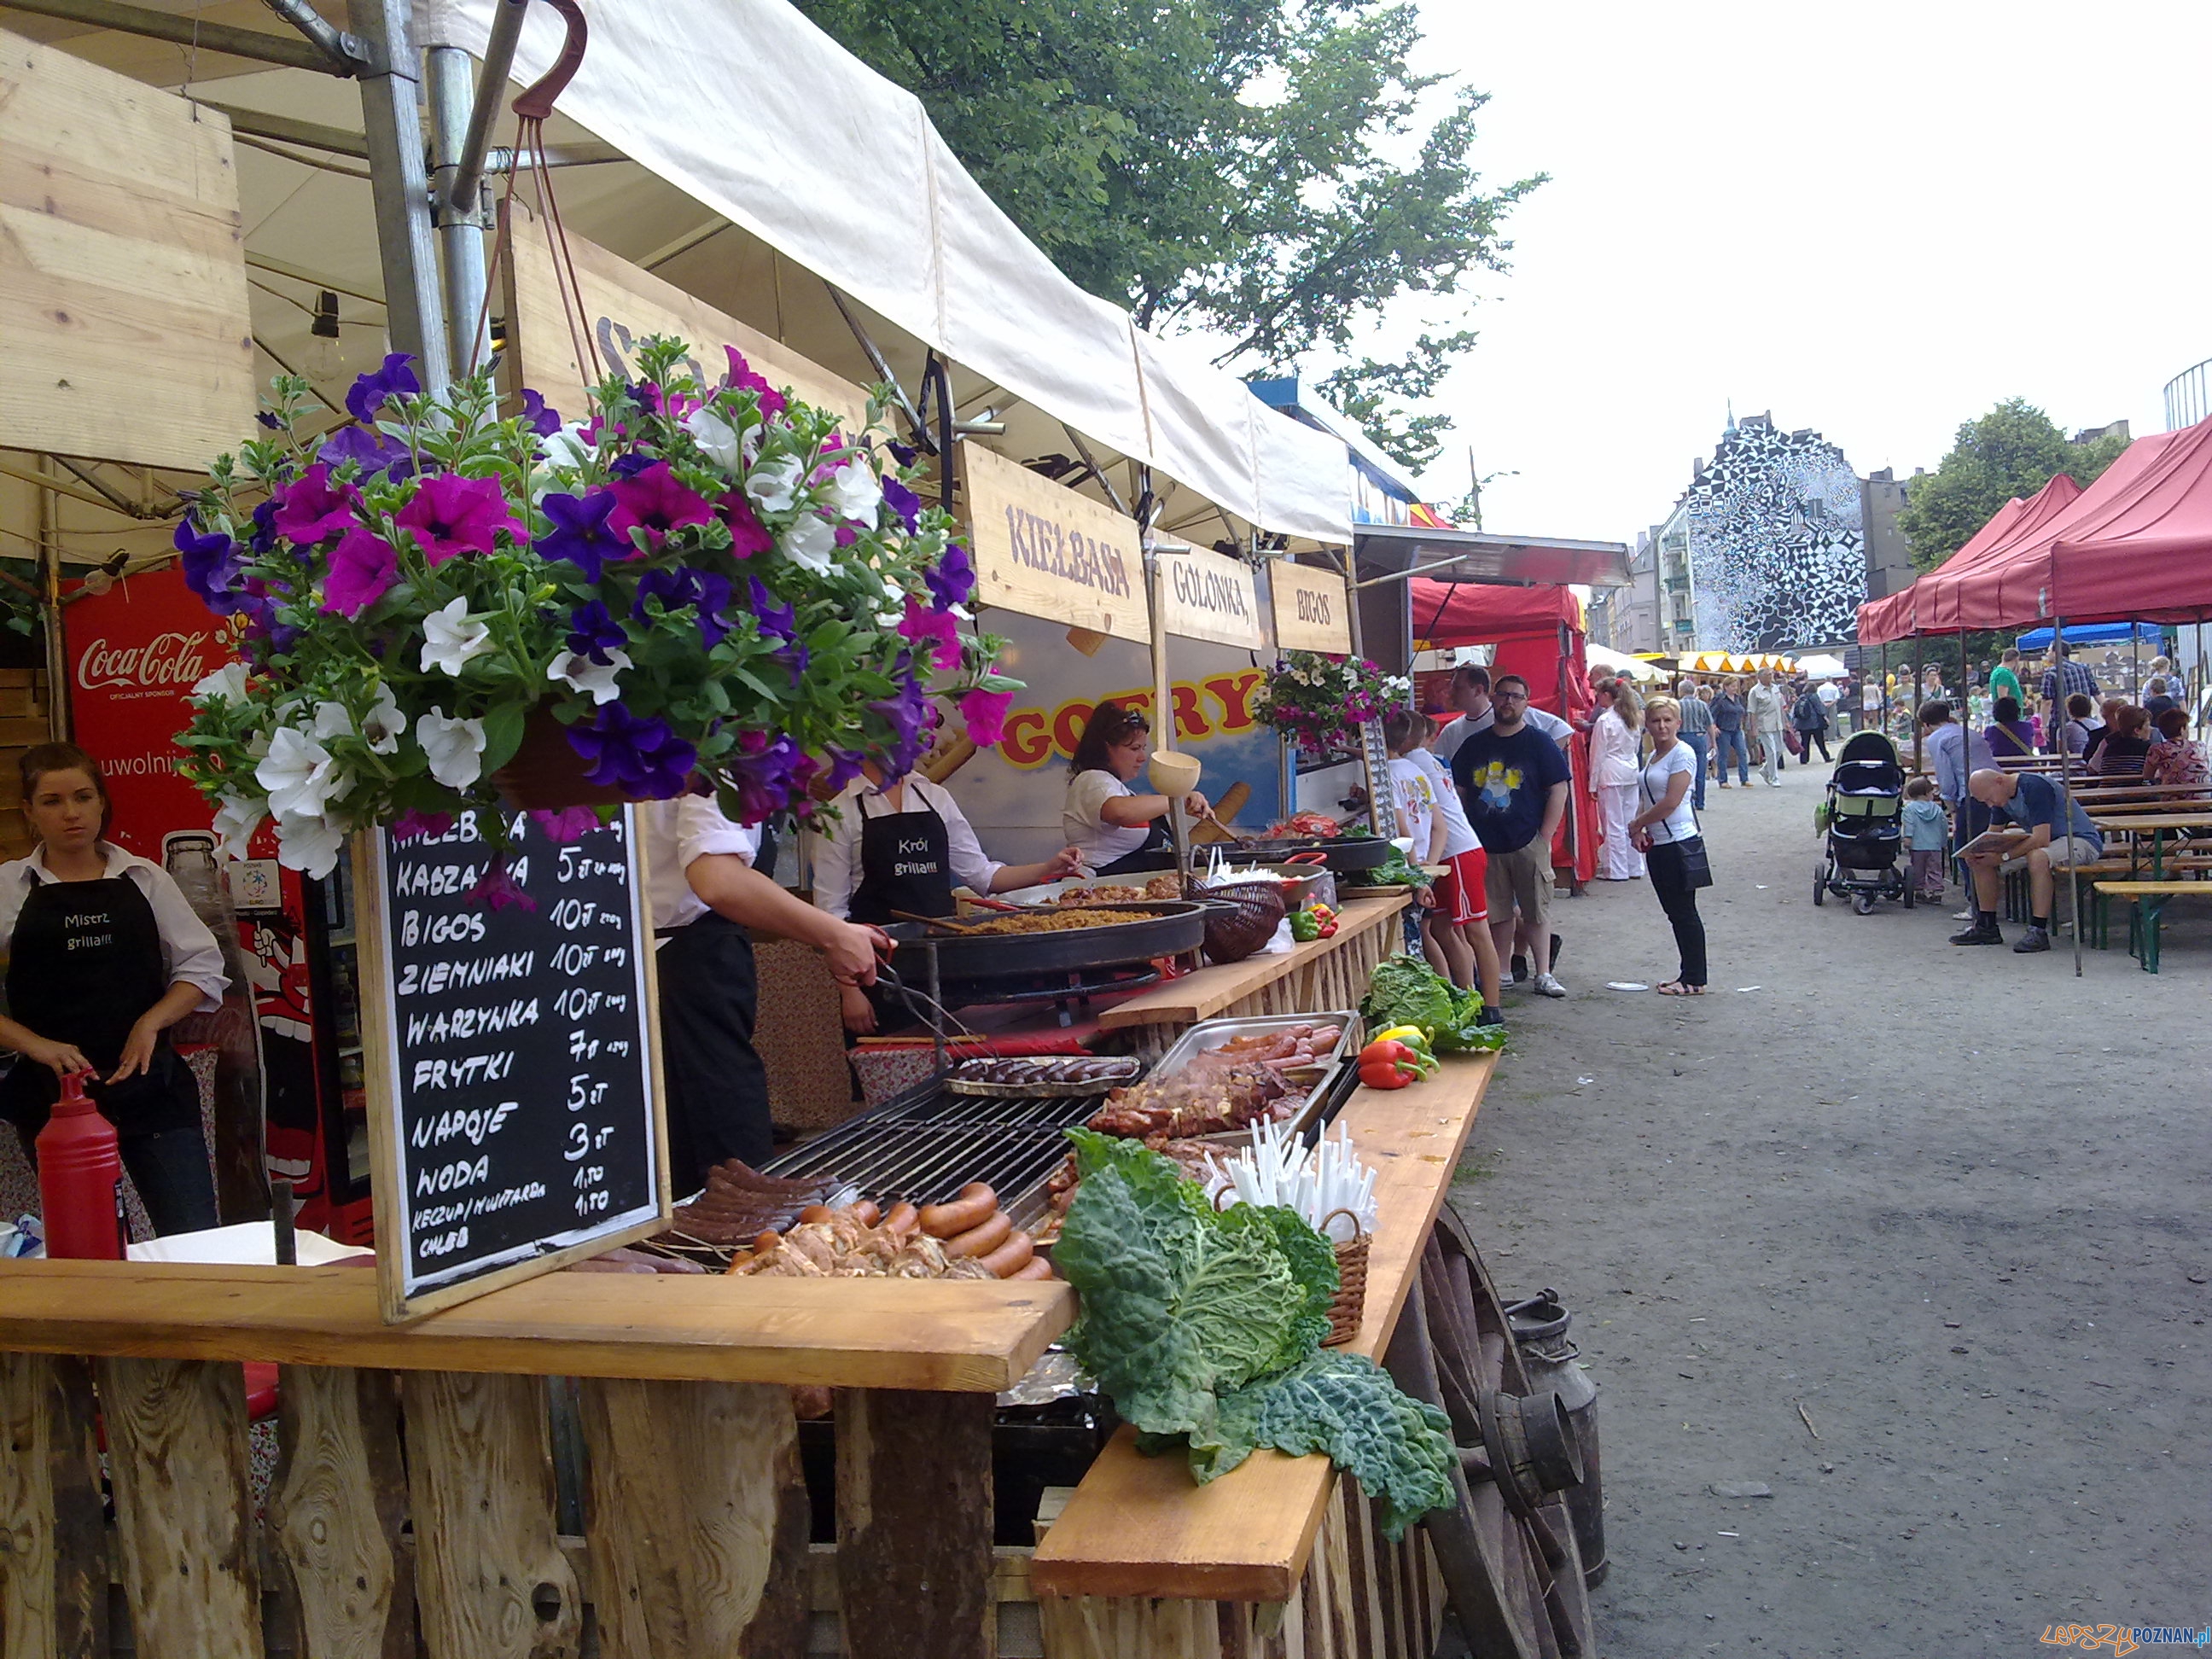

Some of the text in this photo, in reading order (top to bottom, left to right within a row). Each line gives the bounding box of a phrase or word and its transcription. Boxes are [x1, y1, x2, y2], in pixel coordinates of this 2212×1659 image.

[1005, 504, 1131, 599] KIEŁBASA
[1295, 588, 1330, 626] BIGOS
[78, 632, 208, 690] Coca-Cola
[899, 837, 929, 854] Król
[894, 861, 938, 876] grilla!!!
[65, 913, 110, 928] Mistrz
[401, 909, 486, 947] BIGOS
[398, 950, 534, 996] ZIEMNIAKI
[413, 1051, 515, 1094] FRYTKI
[411, 1101, 519, 1149] NAPOJE
[416, 1154, 489, 1198] WODA
